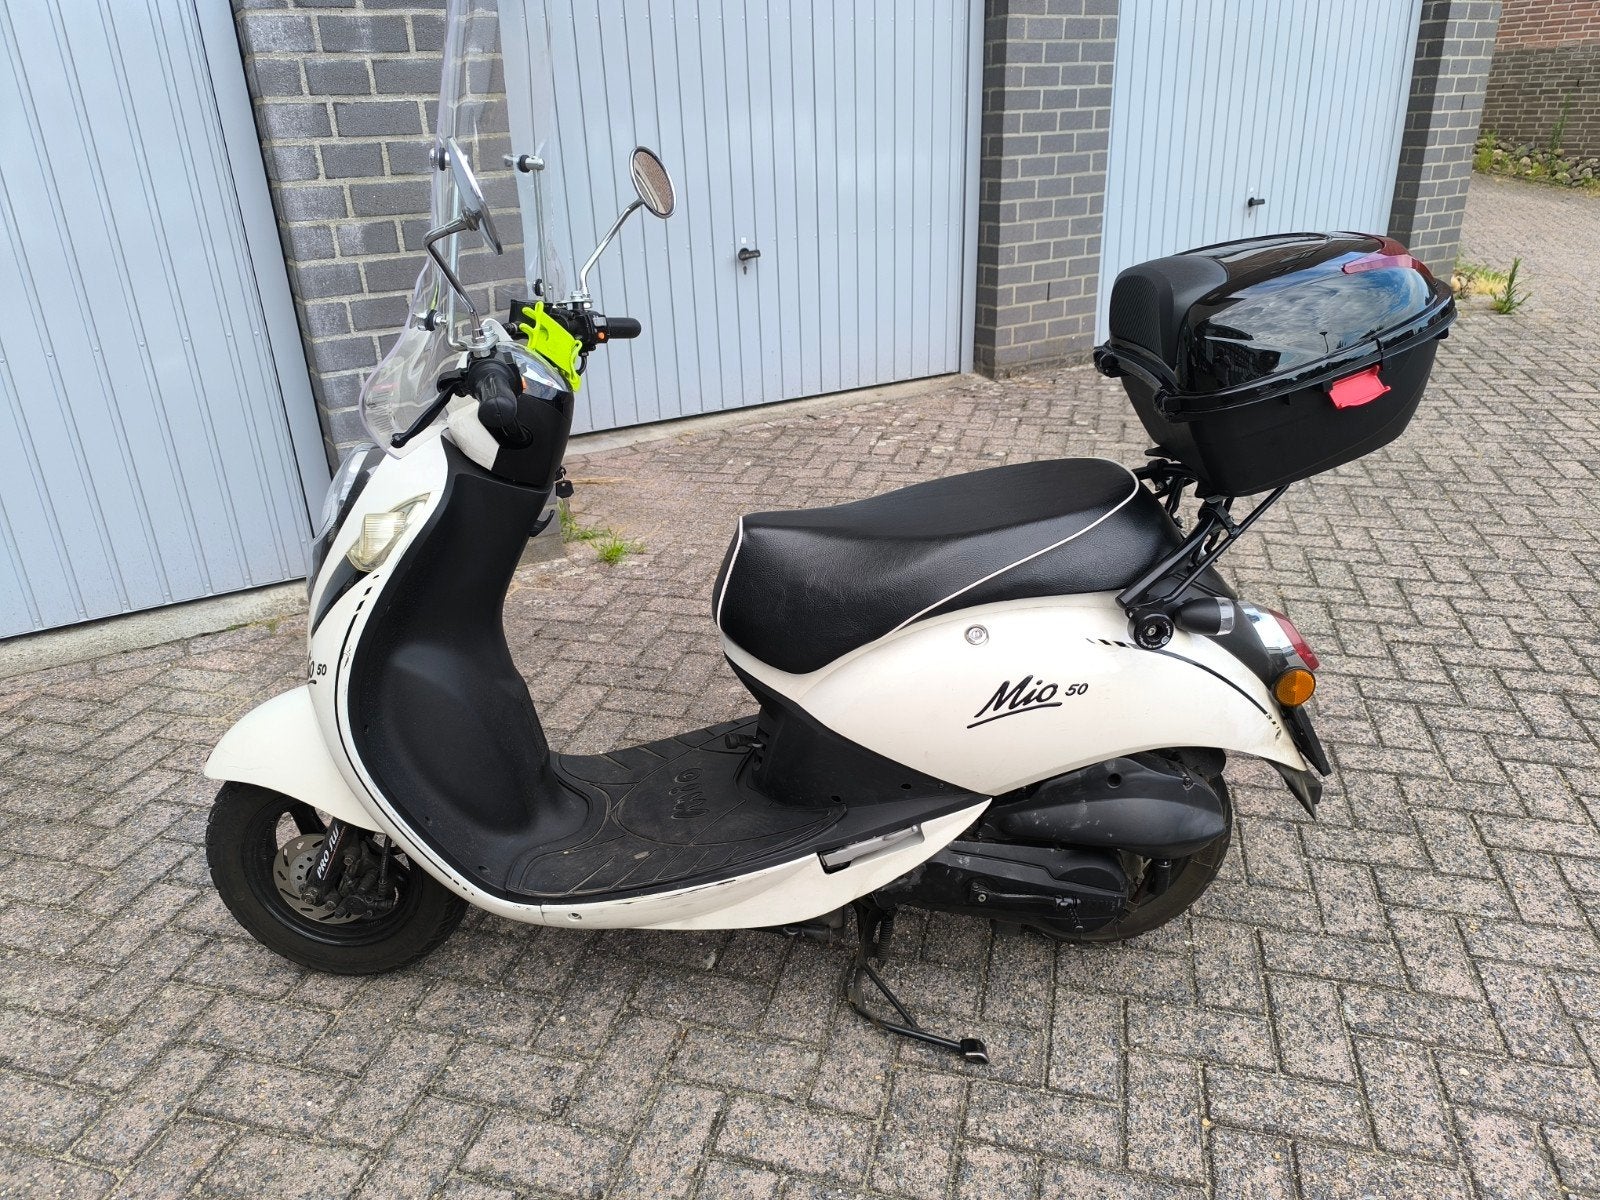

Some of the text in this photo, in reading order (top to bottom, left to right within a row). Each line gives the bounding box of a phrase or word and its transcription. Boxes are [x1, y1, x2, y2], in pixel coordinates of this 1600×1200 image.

[316, 663, 327, 676] 50
[973, 674, 1089, 718] Mio 50
[316, 849, 330, 880] PRO
